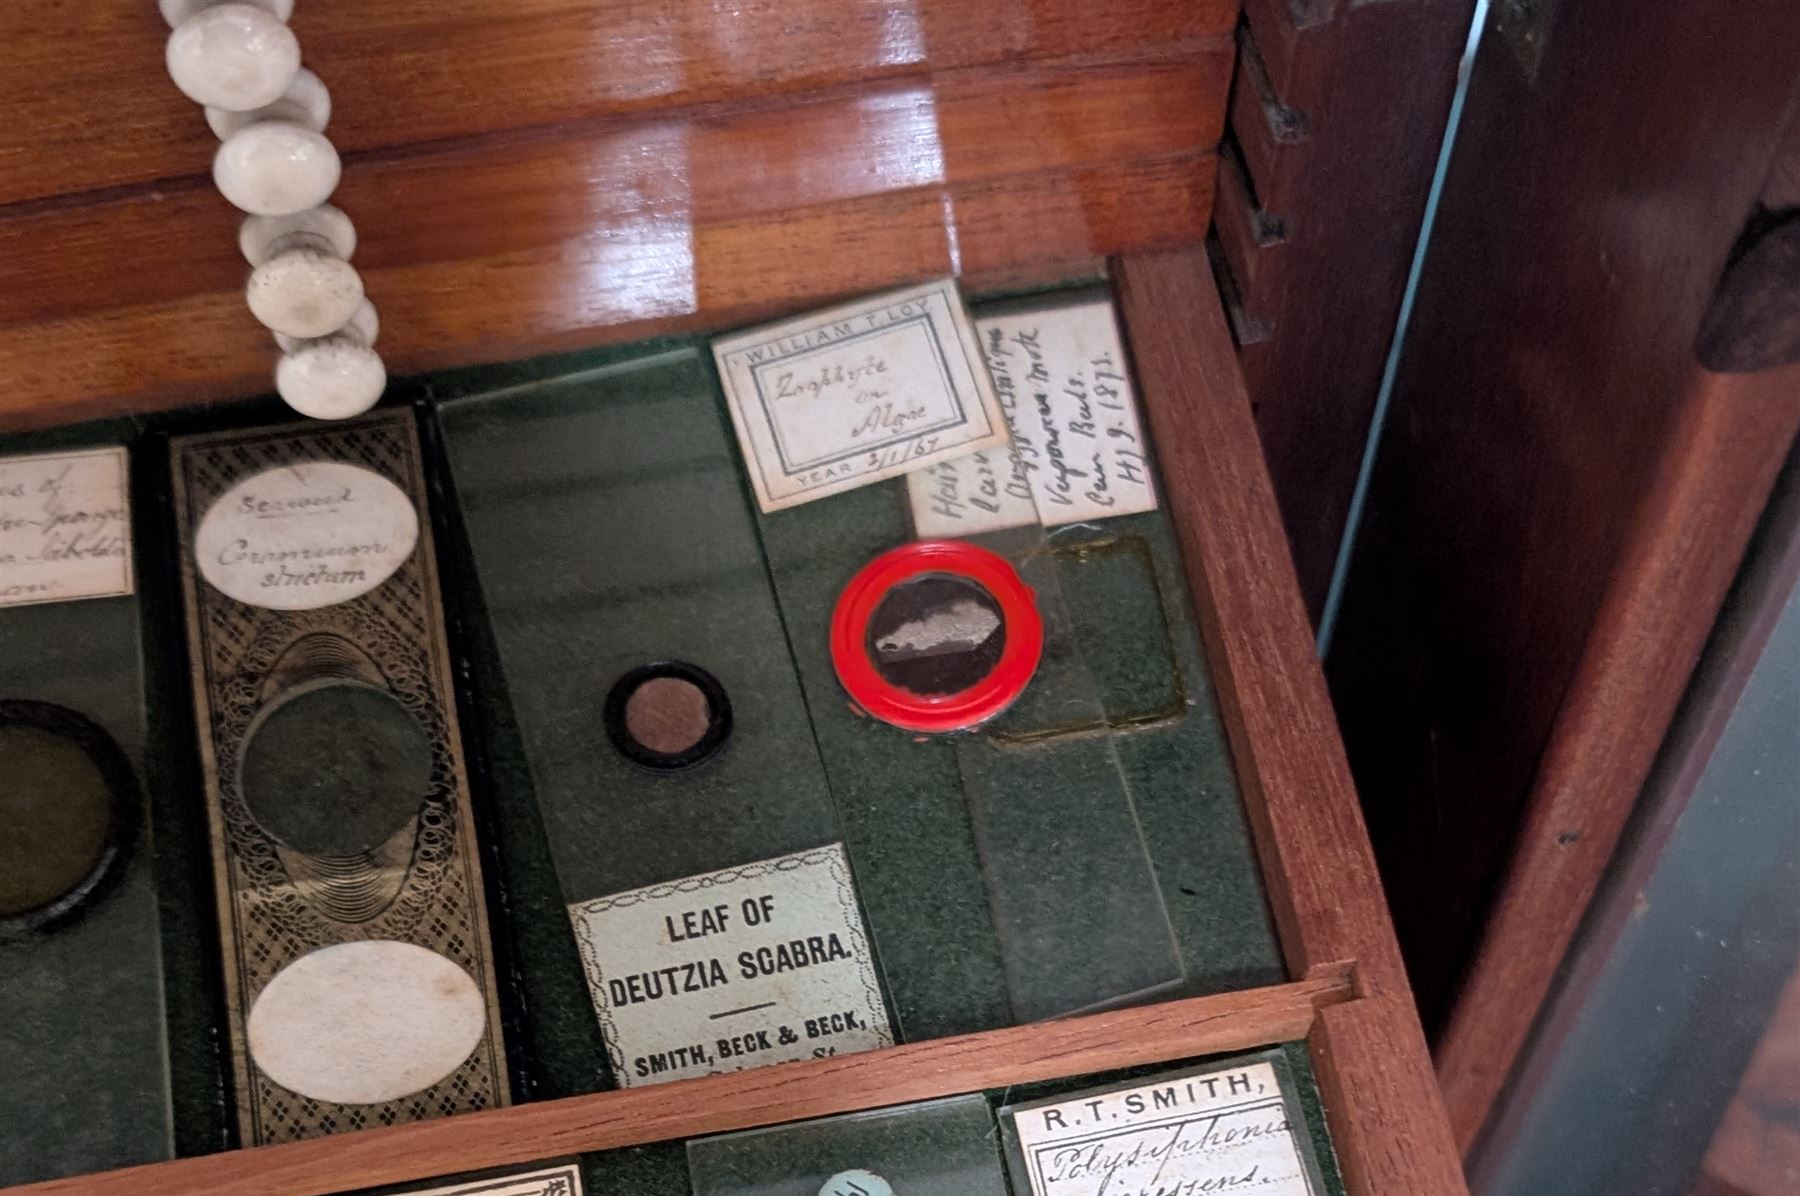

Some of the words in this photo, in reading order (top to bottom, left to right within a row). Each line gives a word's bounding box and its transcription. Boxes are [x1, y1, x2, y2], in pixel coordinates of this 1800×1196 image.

[747, 323, 853, 363] WILLIAM
[797, 463, 853, 486] YEAR
[665, 904, 730, 943] LEAF
[741, 895, 774, 927] OF
[609, 958, 729, 1008] DEUTZIA
[738, 932, 853, 980] SCABRA.
[635, 1047, 714, 1078] SMITH,
[718, 1031, 772, 1060] BECK
[777, 1026, 799, 1046] &
[803, 1011, 867, 1040] BECK,
